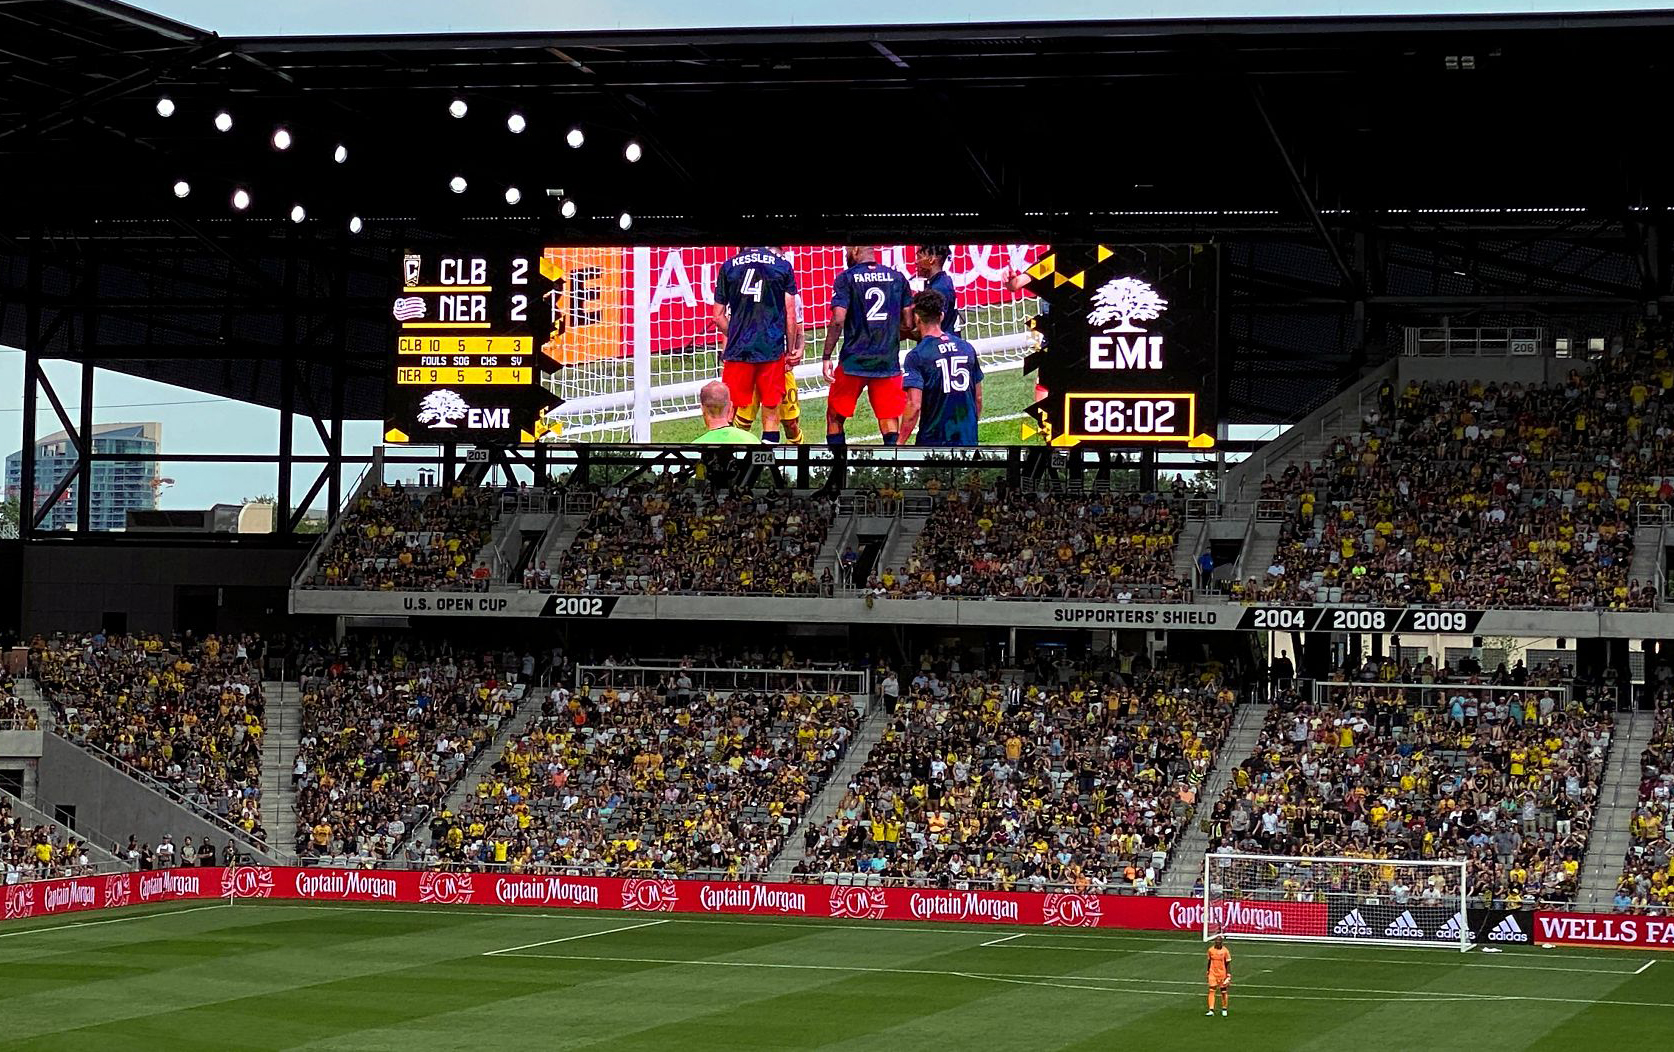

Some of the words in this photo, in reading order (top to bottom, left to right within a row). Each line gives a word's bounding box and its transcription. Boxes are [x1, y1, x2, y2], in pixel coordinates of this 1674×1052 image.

[732, 253, 776, 267] KESSLER
[440, 258, 487, 285] CLB
[512, 258, 528, 285] 2
[853, 272, 894, 283] FARRELL
[740, 268, 763, 303] 4
[439, 295, 487, 321] NER
[510, 294, 527, 321] 2
[865, 287, 887, 321] 2
[400, 339, 422, 352] CLB
[429, 339, 440, 352] 10
[458, 339, 466, 352] 5
[486, 339, 492, 352] 7
[513, 339, 521, 352] 3
[937, 342, 958, 354] BYE
[1089, 336, 1164, 370] EMI
[1513, 343, 1534, 353] 206
[421, 356, 447, 366] FOULS
[453, 356, 470, 366] SOG
[480, 356, 498, 366] CHS
[510, 356, 523, 366] SV
[398, 369, 421, 382] NER
[430, 369, 438, 382] 9
[457, 369, 465, 382] 5
[485, 369, 493, 382] 3
[513, 369, 520, 382] 4
[935, 355, 971, 394] 15
[468, 408, 511, 429] EMI
[1084, 400, 1175, 433] 86:02
[468, 451, 486, 460] 203
[754, 453, 773, 463] 204
[404, 597, 432, 611] U.S.
[436, 597, 474, 611] OPEN
[478, 598, 508, 612] CUP
[555, 597, 603, 615] 2002
[1162, 611, 1217, 625] SHIELD
[1253, 609, 1305, 628] 2004
[1333, 611, 1386, 630] 2008
[1413, 612, 1467, 631] 2009
[140, 872, 163, 900] Captain
[161, 871, 199, 898] Morgan
[295, 871, 344, 897] Captain
[343, 871, 397, 898] Morgan
[495, 877, 545, 904] Captain
[543, 877, 599, 904] Morgan
[44, 882, 69, 912] Captain
[68, 881, 95, 909] Morgan
[700, 884, 750, 911] Captain
[749, 884, 806, 912] Morgan
[909, 892, 962, 919] Captain
[961, 892, 1018, 921] Morgan
[1221, 901, 1283, 930] Morgan
[1384, 926, 1424, 938] adidas
[1436, 928, 1476, 940] adids
[1487, 929, 1528, 942] adidas
[1539, 917, 1638, 942] WELLS
